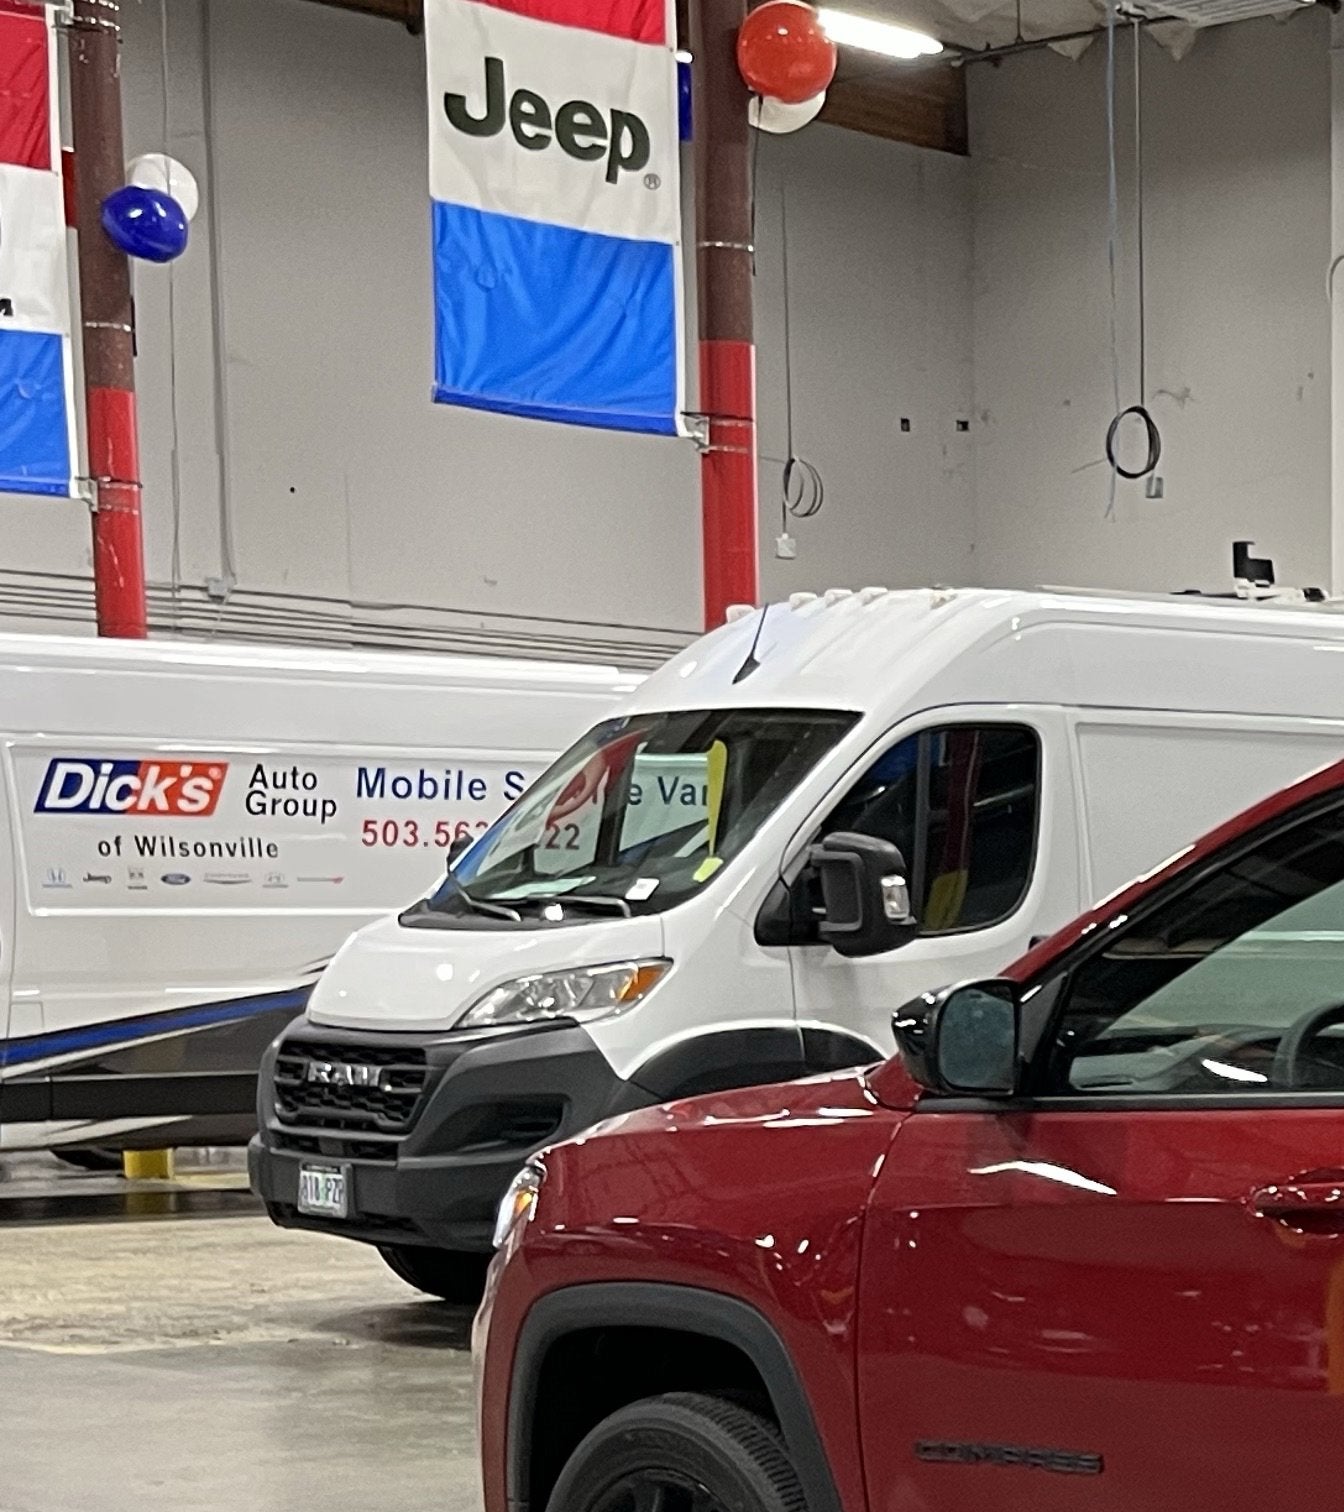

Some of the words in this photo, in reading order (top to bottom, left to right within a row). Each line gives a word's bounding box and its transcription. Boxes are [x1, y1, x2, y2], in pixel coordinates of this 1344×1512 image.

[444, 56, 651, 185] Jeep
[44, 762, 214, 812] Dick's
[248, 763, 318, 791] Auto
[356, 766, 487, 801] Mobile
[657, 775, 709, 806] Va
[245, 790, 338, 824] Group
[97, 835, 122, 857] of
[134, 834, 279, 858] Wilsonville
